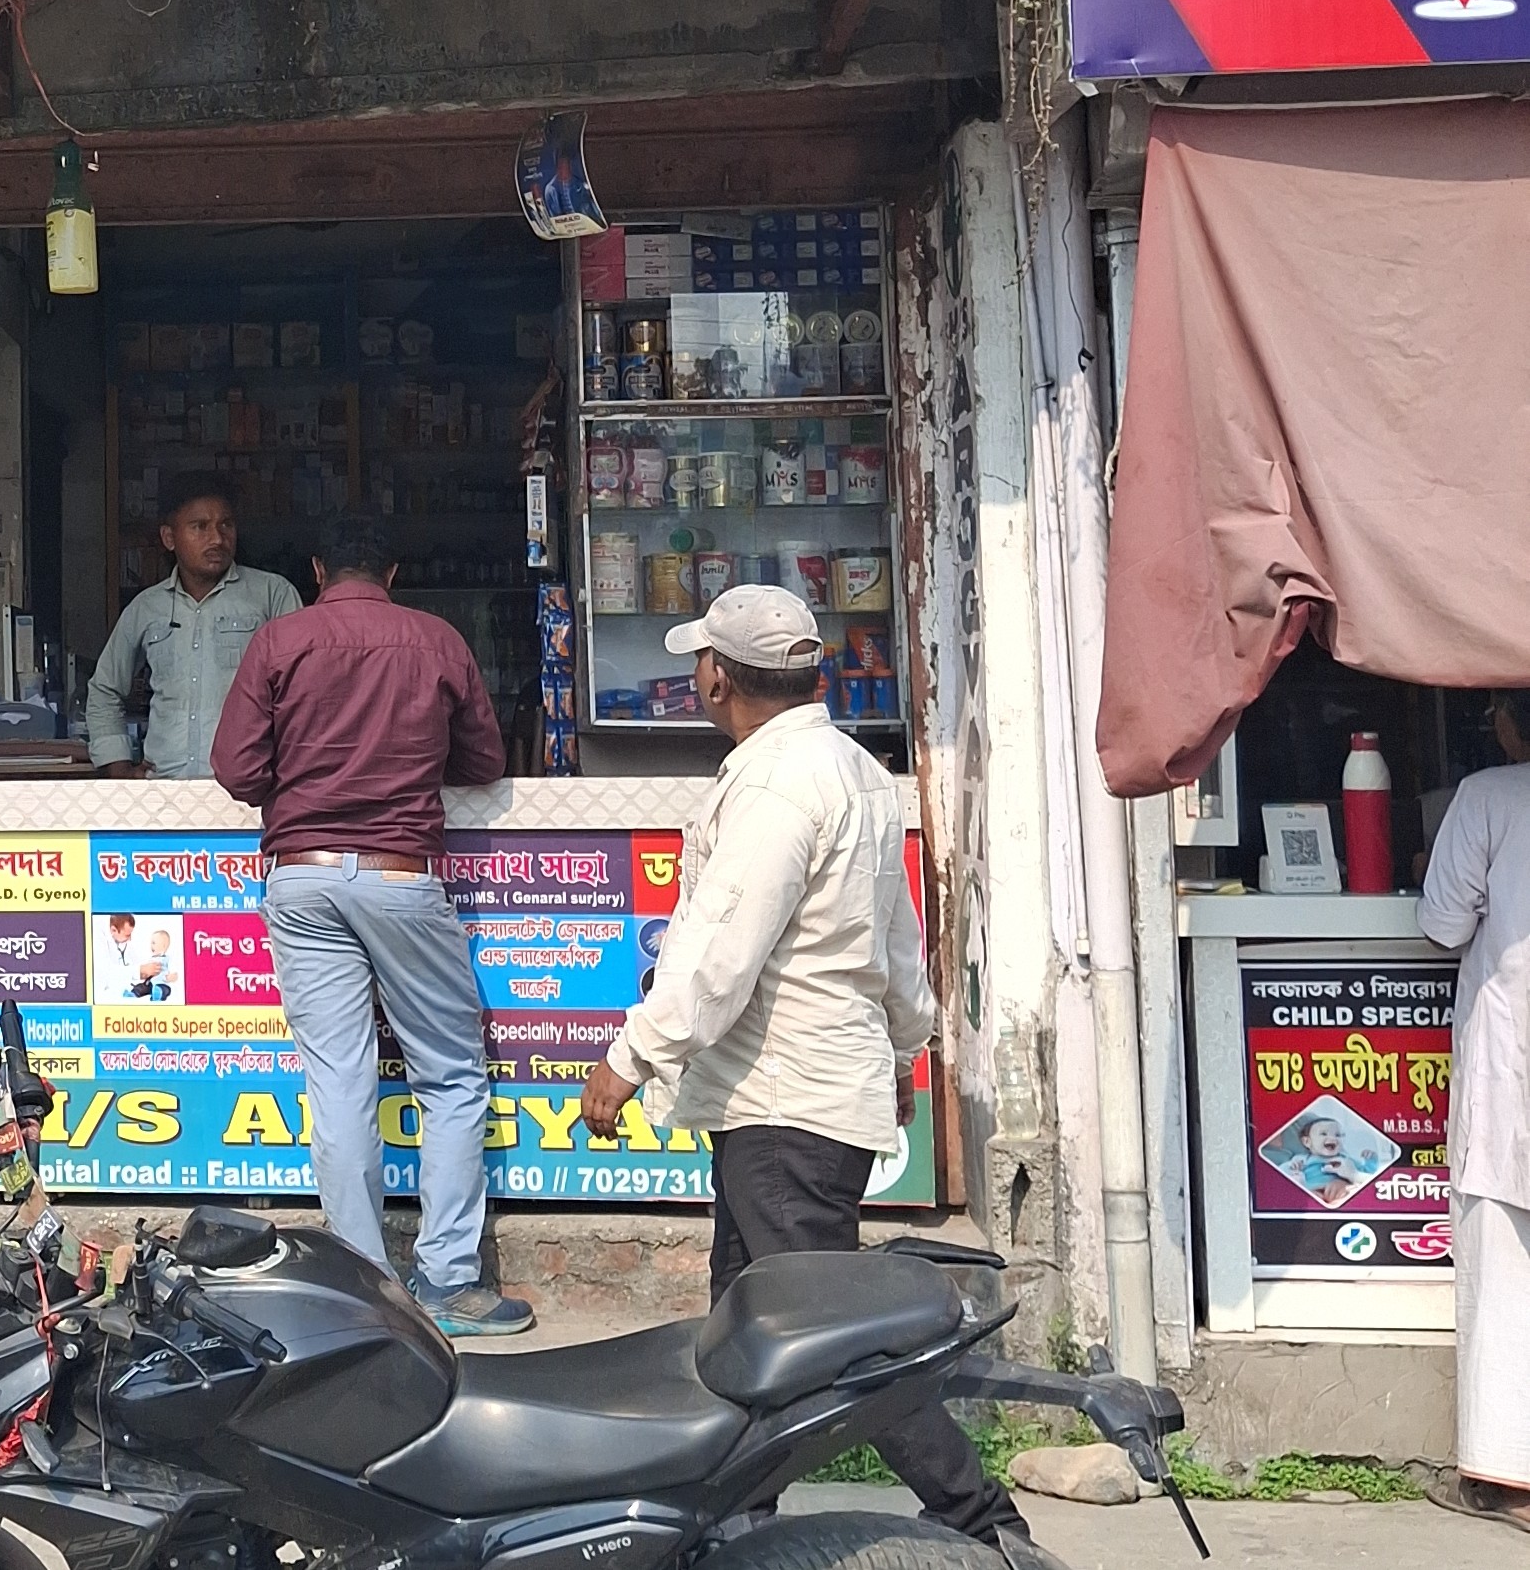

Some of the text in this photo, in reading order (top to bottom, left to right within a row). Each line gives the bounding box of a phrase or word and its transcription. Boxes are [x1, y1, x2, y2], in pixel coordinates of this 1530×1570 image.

[133, 850, 210, 881] কল্যাণ
[539, 851, 609, 887] সাহা
[172, 897, 260, 908] M.B.B.S. M.
[571, 892, 625, 906] surjery)
[194, 931, 233, 955] শিশু
[239, 939, 255, 954] ও
[1252, 981, 1343, 999] নবজাতক
[1349, 982, 1365, 998] ও
[104, 1017, 288, 1038] Falakata Super Speciality
[1272, 1006, 1454, 1026] CHILD SPECIA
[27, 1019, 83, 1044] Hospital
[490, 1021, 564, 1044] Speciality
[567, 1022, 626, 1043] Hospita
[101, 1053, 128, 1069] বসেন
[130, 1044, 152, 1069] প্রতি
[155, 1051, 177, 1070] সোম
[181, 1051, 208, 1072] থেকে
[278, 1052, 305, 1072] সকা
[1312, 1033, 1398, 1094] অতীশ
[1406, 1052, 1452, 1113] কুম
[109, 1160, 171, 1184] road
[208, 1161, 318, 1186] Falakat
[578, 1168, 714, 1194] 7029731
